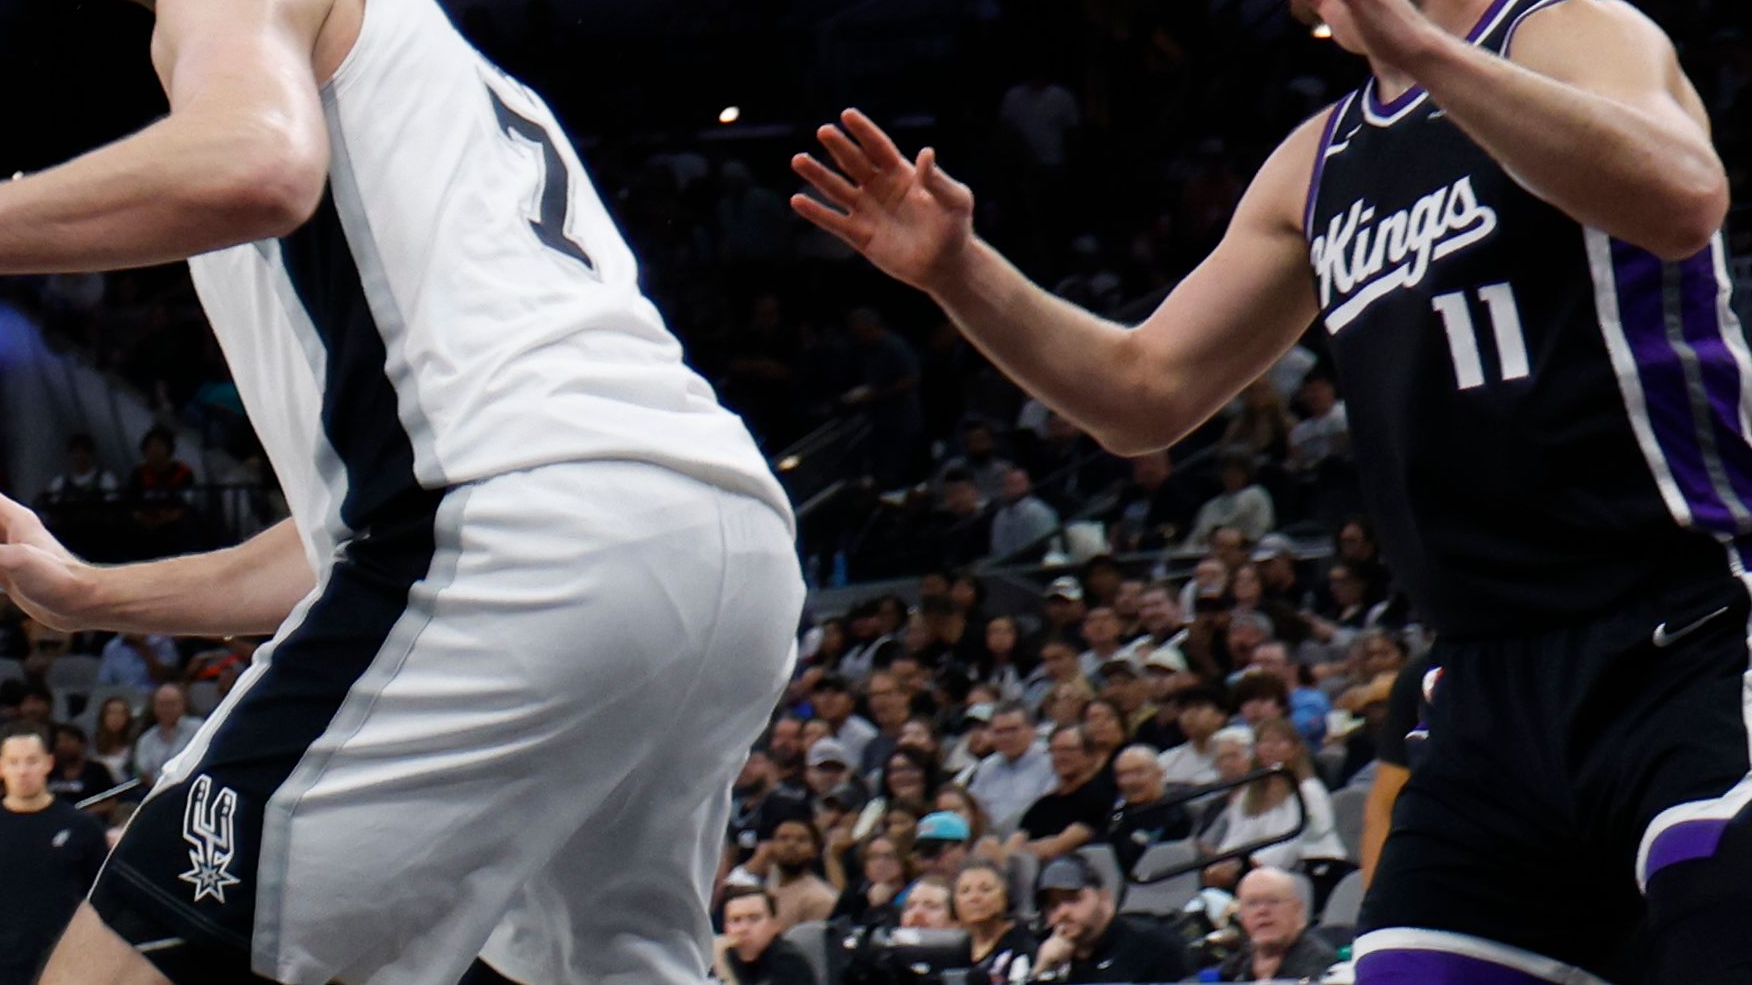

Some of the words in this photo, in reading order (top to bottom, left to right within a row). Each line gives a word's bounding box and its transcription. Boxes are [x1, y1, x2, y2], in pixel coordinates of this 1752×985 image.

[480, 72, 600, 277] 7
[1310, 175, 1497, 335] Kings
[1431, 281, 1530, 391] 11
